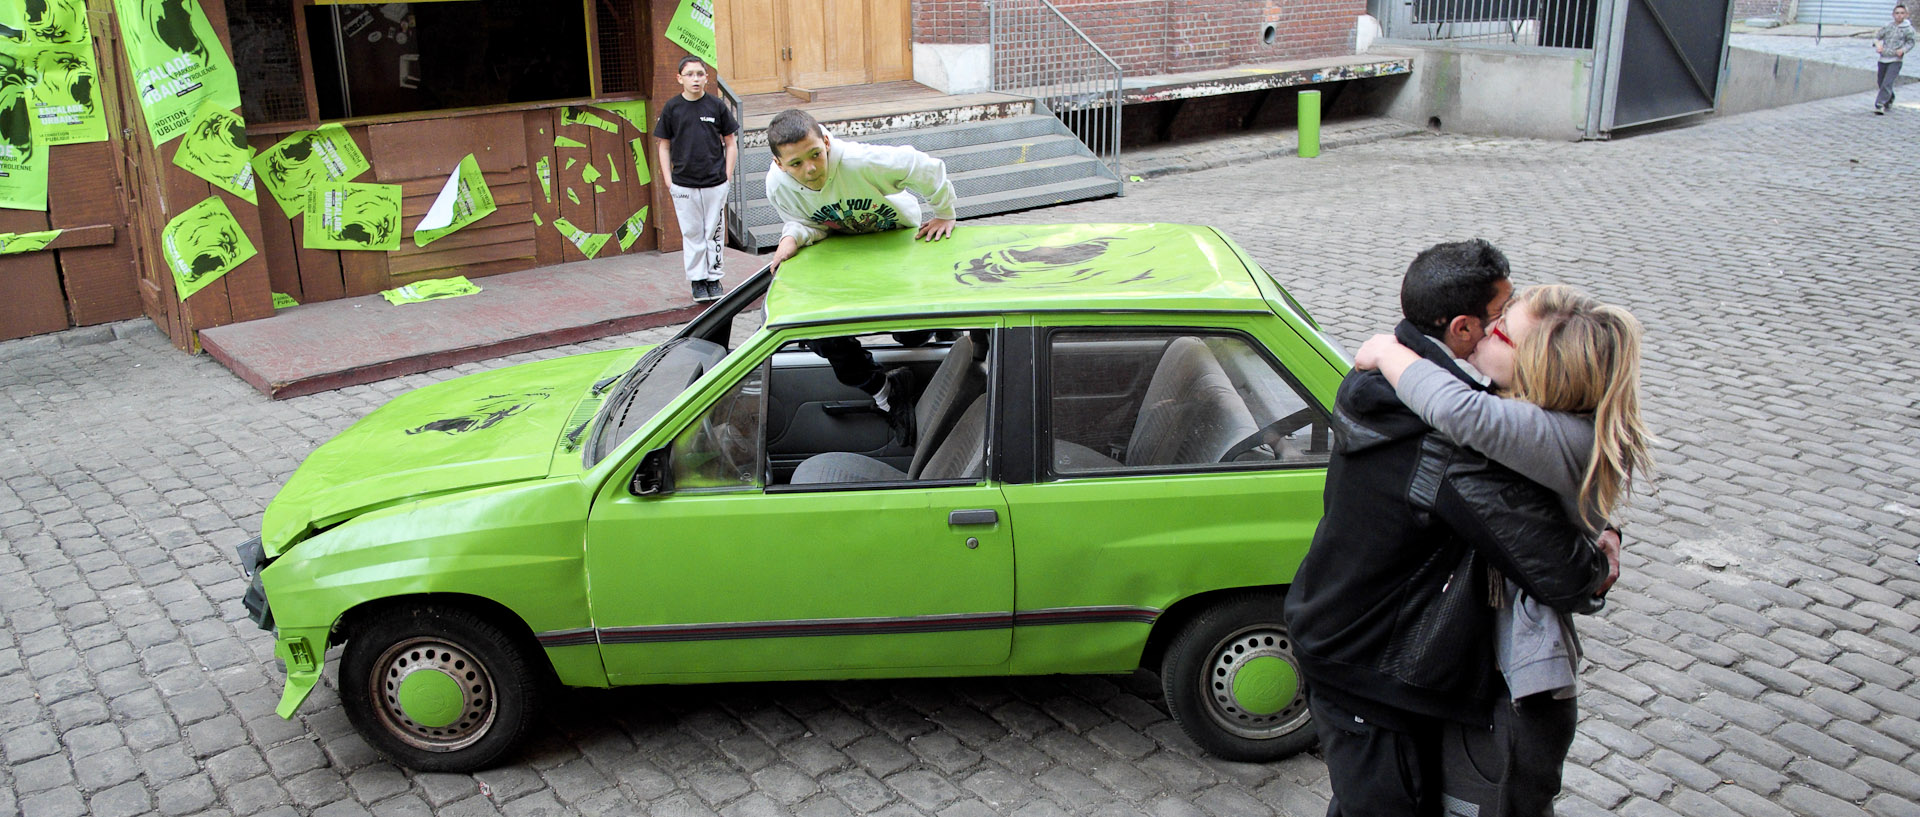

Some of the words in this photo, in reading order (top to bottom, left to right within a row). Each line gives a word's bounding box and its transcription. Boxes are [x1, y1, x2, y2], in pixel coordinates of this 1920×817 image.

[680, 34, 707, 55] PUBLIQUE
[682, 29, 710, 49] CONDITION
[174, 62, 201, 78] PARKOUR
[39, 104, 83, 114] ESCALADE
[847, 199, 872, 210] YOU
